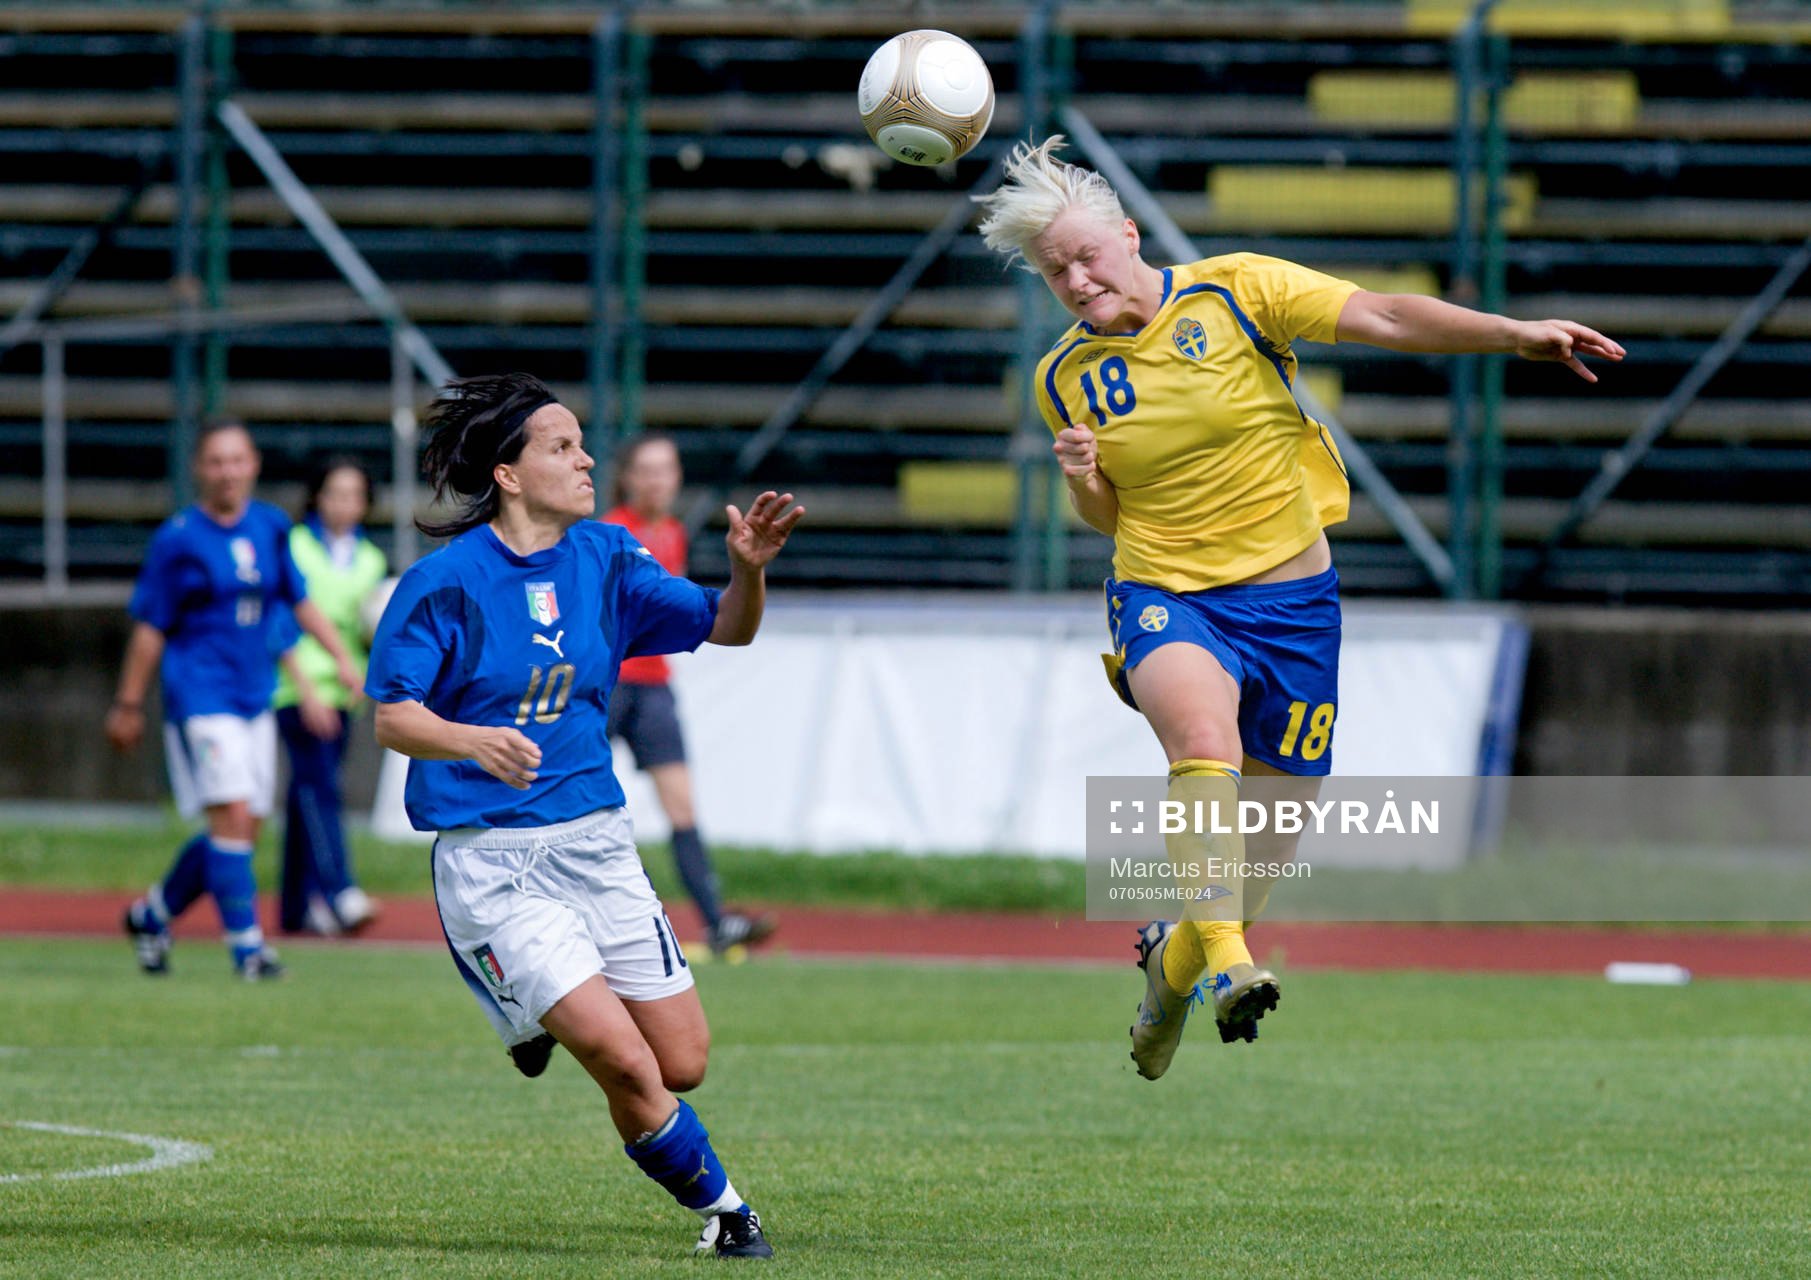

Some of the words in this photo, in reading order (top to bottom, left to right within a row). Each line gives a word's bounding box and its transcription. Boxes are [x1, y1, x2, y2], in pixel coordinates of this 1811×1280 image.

[1080, 356, 1137, 427] 18
[515, 662, 576, 726] 10
[1279, 701, 1335, 761] 18
